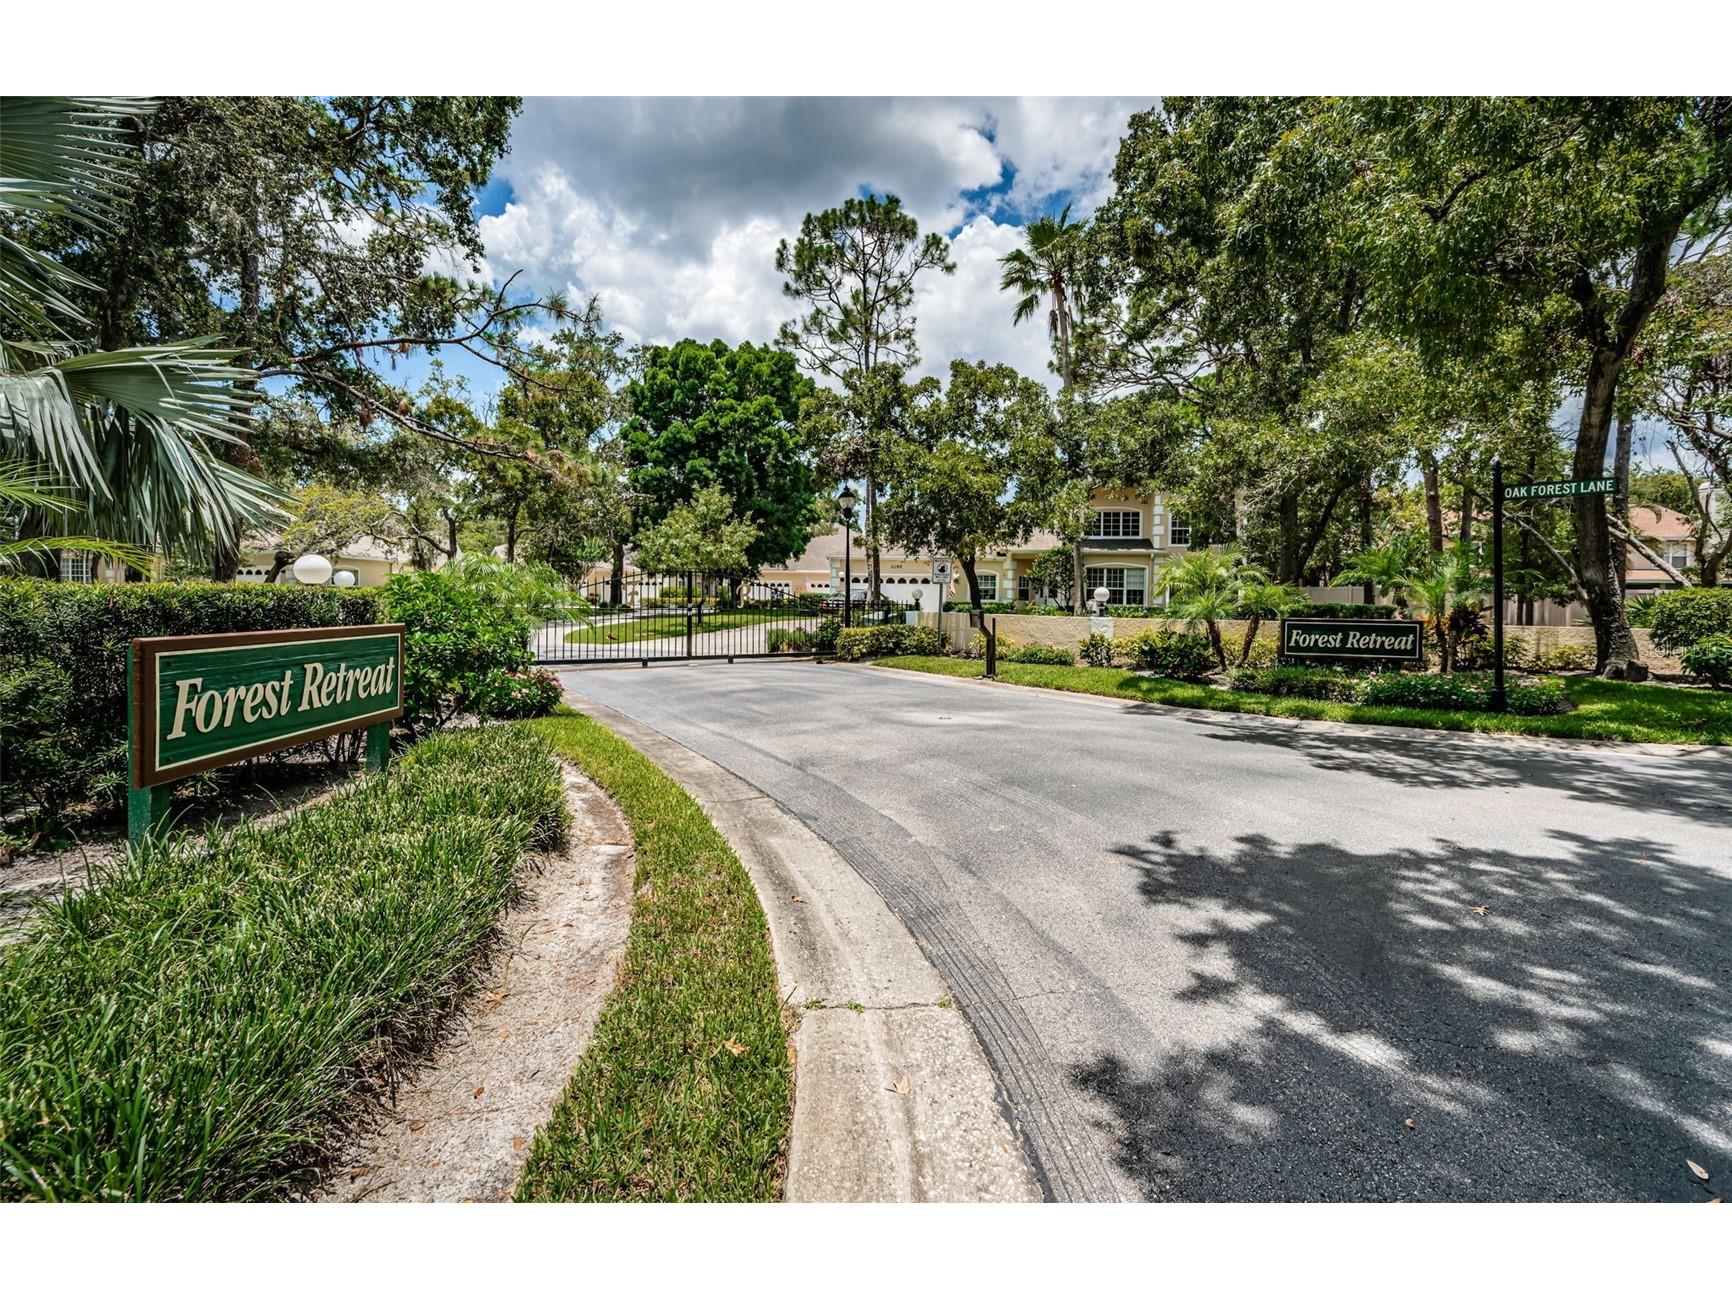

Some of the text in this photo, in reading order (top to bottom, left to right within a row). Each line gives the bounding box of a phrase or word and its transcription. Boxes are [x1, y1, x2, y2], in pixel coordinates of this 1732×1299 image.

[1504, 480, 1615, 498] OAK FOREST LANE
[1288, 629, 1415, 649] Forest Retreat
[167, 656, 395, 740] Forest Retreat
